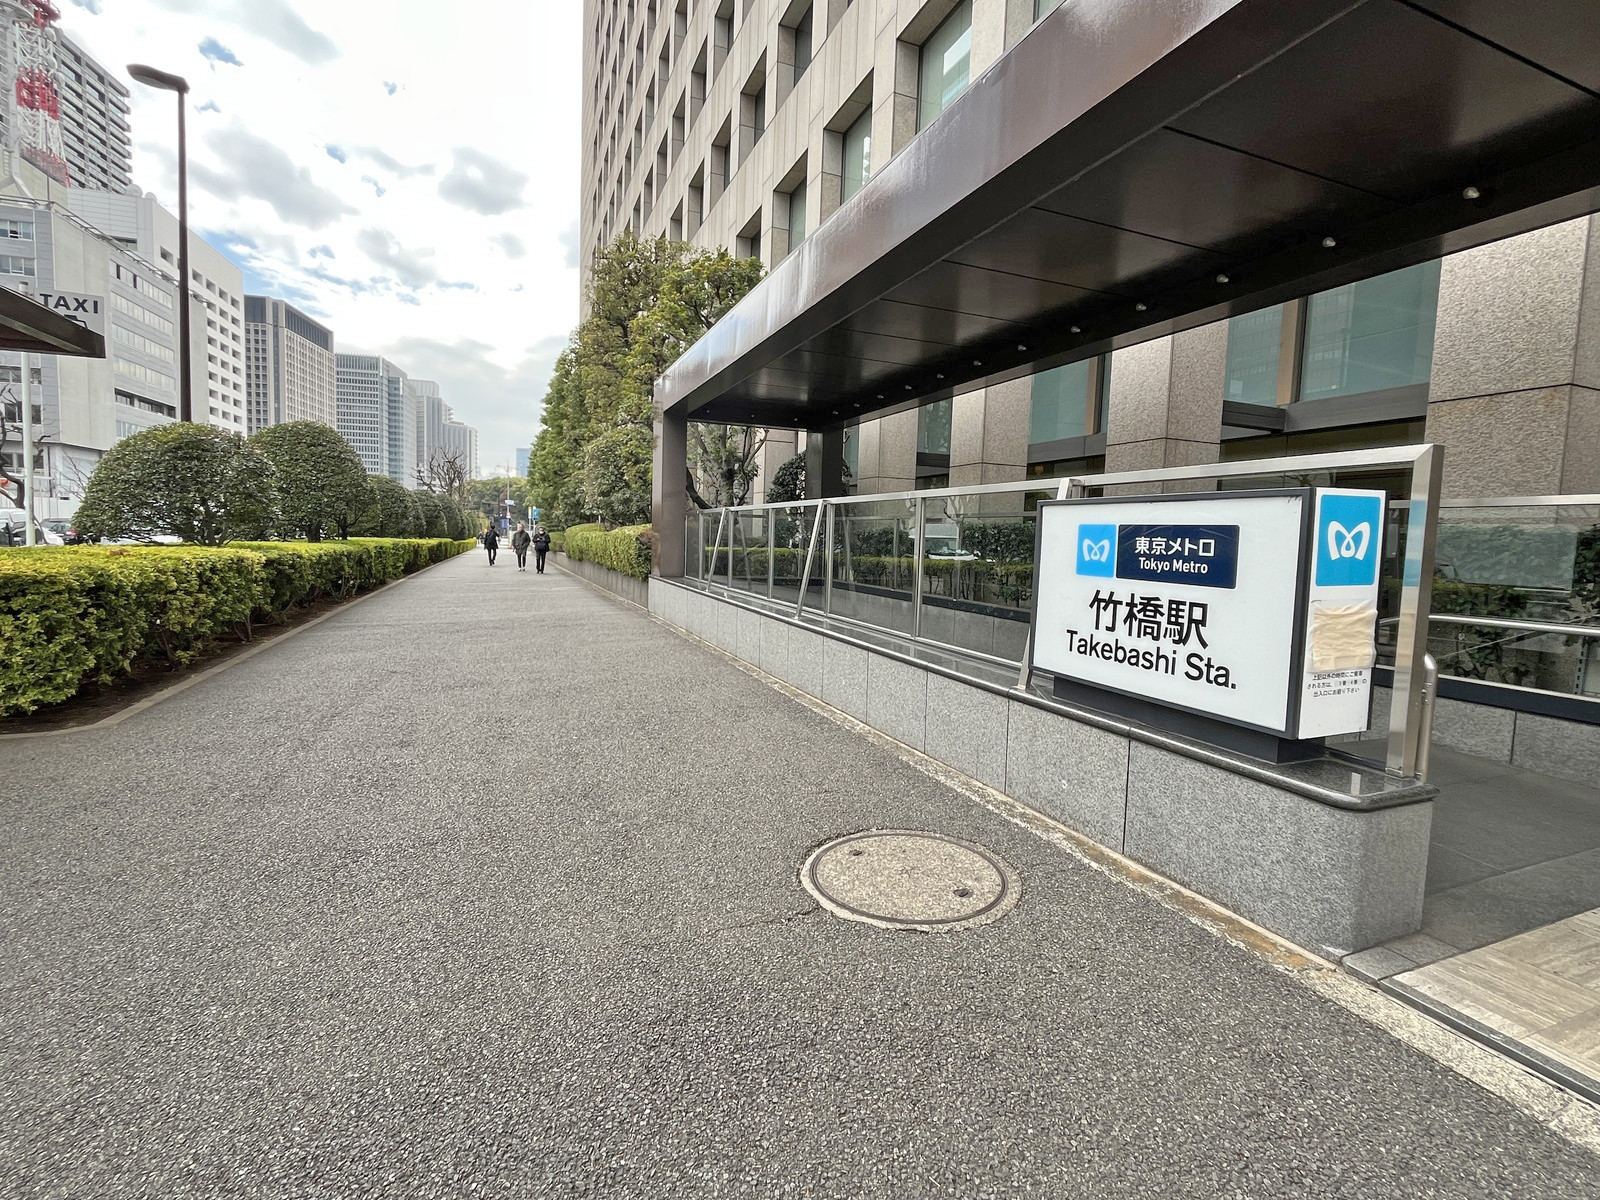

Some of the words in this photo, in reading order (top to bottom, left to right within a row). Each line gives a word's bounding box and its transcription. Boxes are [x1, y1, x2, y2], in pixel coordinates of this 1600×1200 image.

[39, 293, 99, 314] TAXI
[1134, 536, 1215, 557] 東京メトロ
[1139, 557, 1170, 573] Tokyo
[1173, 558, 1208, 574] Metro
[1089, 589, 1209, 650] 竹橋駅
[1066, 629, 1177, 675] Takebashi
[1184, 652, 1237, 690] Sta.
